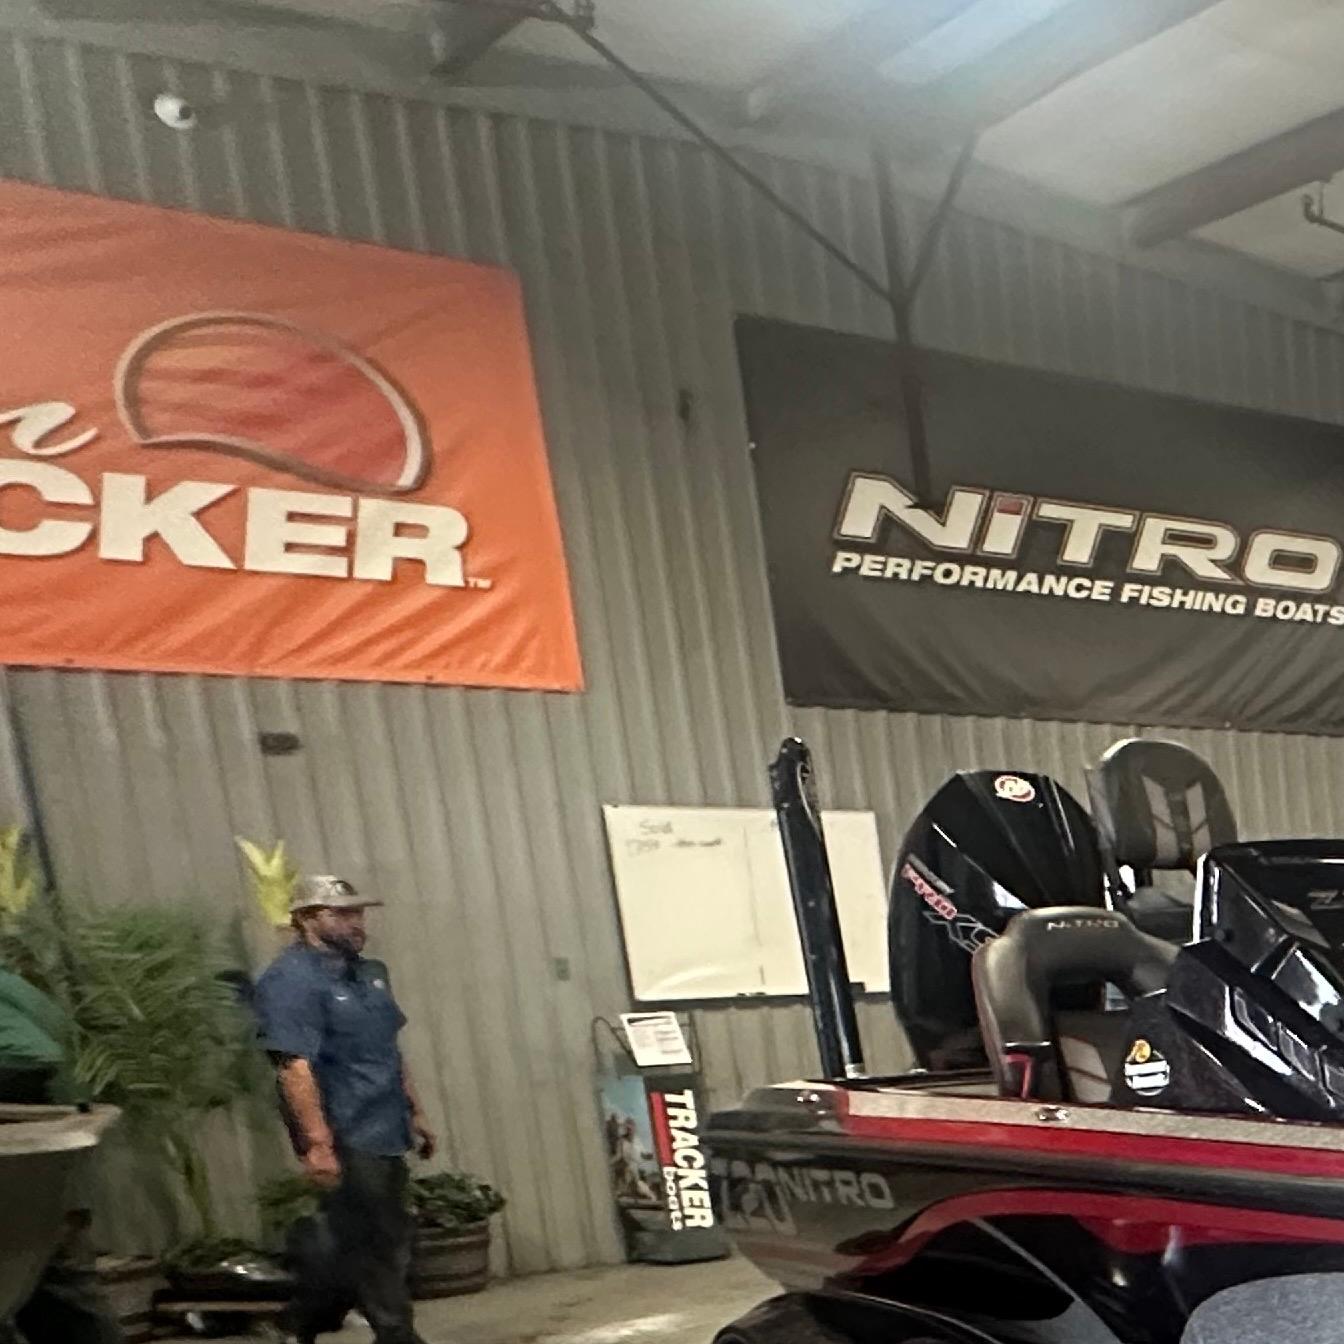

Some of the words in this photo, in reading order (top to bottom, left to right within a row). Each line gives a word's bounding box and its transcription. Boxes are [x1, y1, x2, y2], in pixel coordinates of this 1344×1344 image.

[832, 551, 1113, 602] PERFORMANCE
[1120, 582, 1246, 616] FISHING
[835, 472, 1342, 592] NITRO
[664, 1089, 714, 1228] TRACKER
